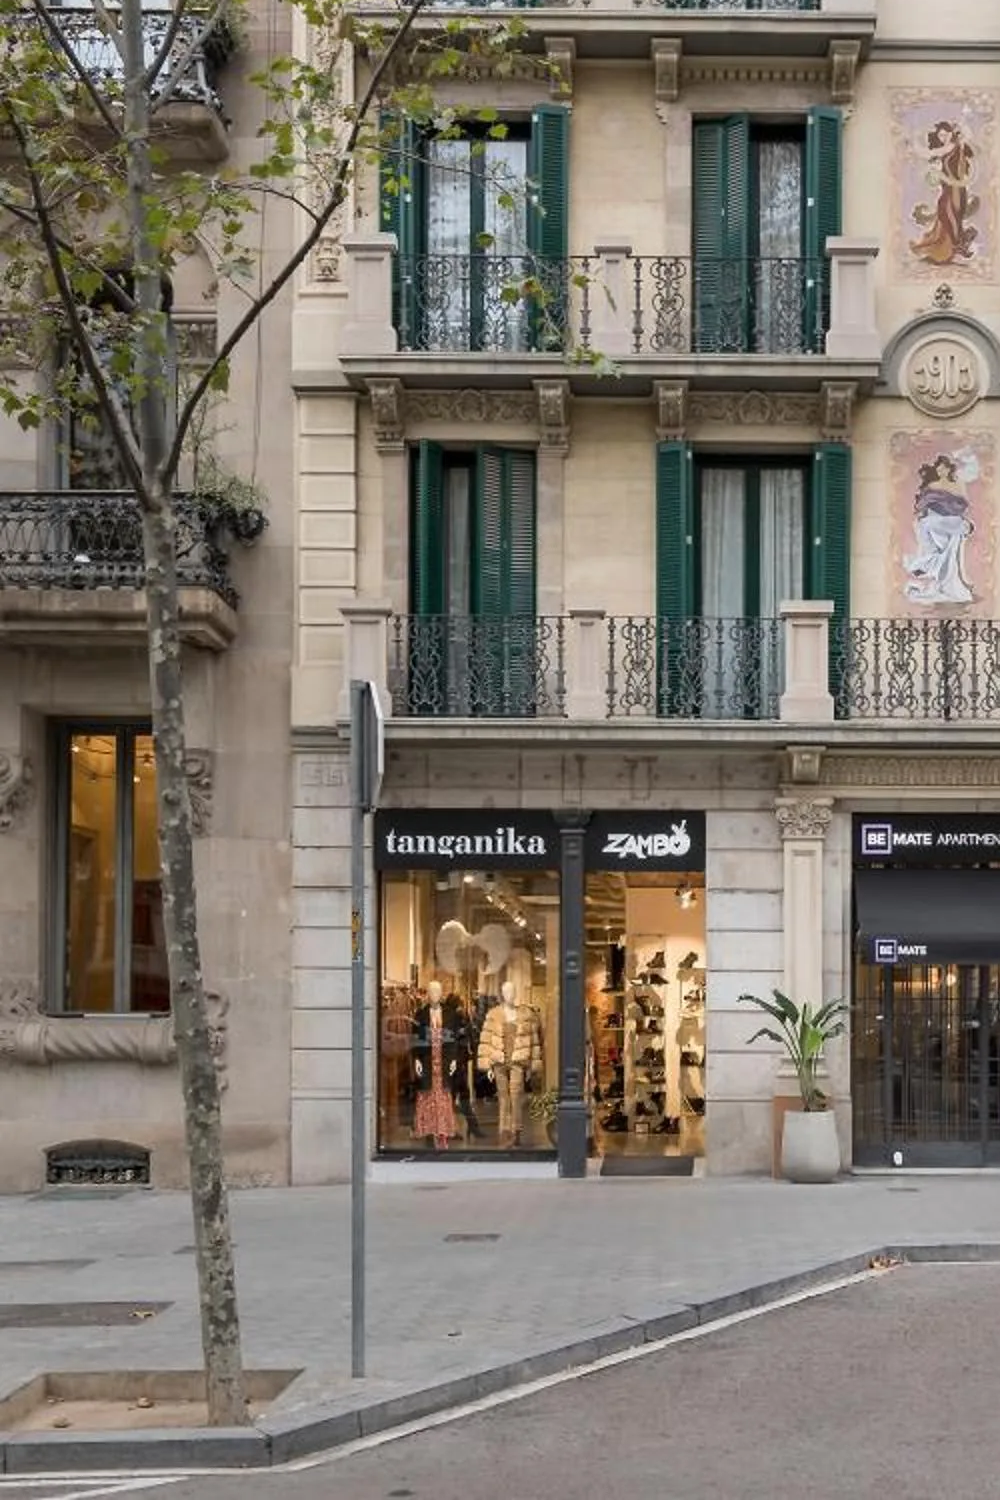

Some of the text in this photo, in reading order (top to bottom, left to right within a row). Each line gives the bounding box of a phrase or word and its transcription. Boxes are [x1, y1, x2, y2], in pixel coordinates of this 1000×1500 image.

[385, 827, 547, 859] tanganika
[602, 819, 691, 859] ZAMBO
[867, 833, 886, 845] BE
[893, 833, 932, 845] MATE
[879, 945, 927, 955] BE MATE
